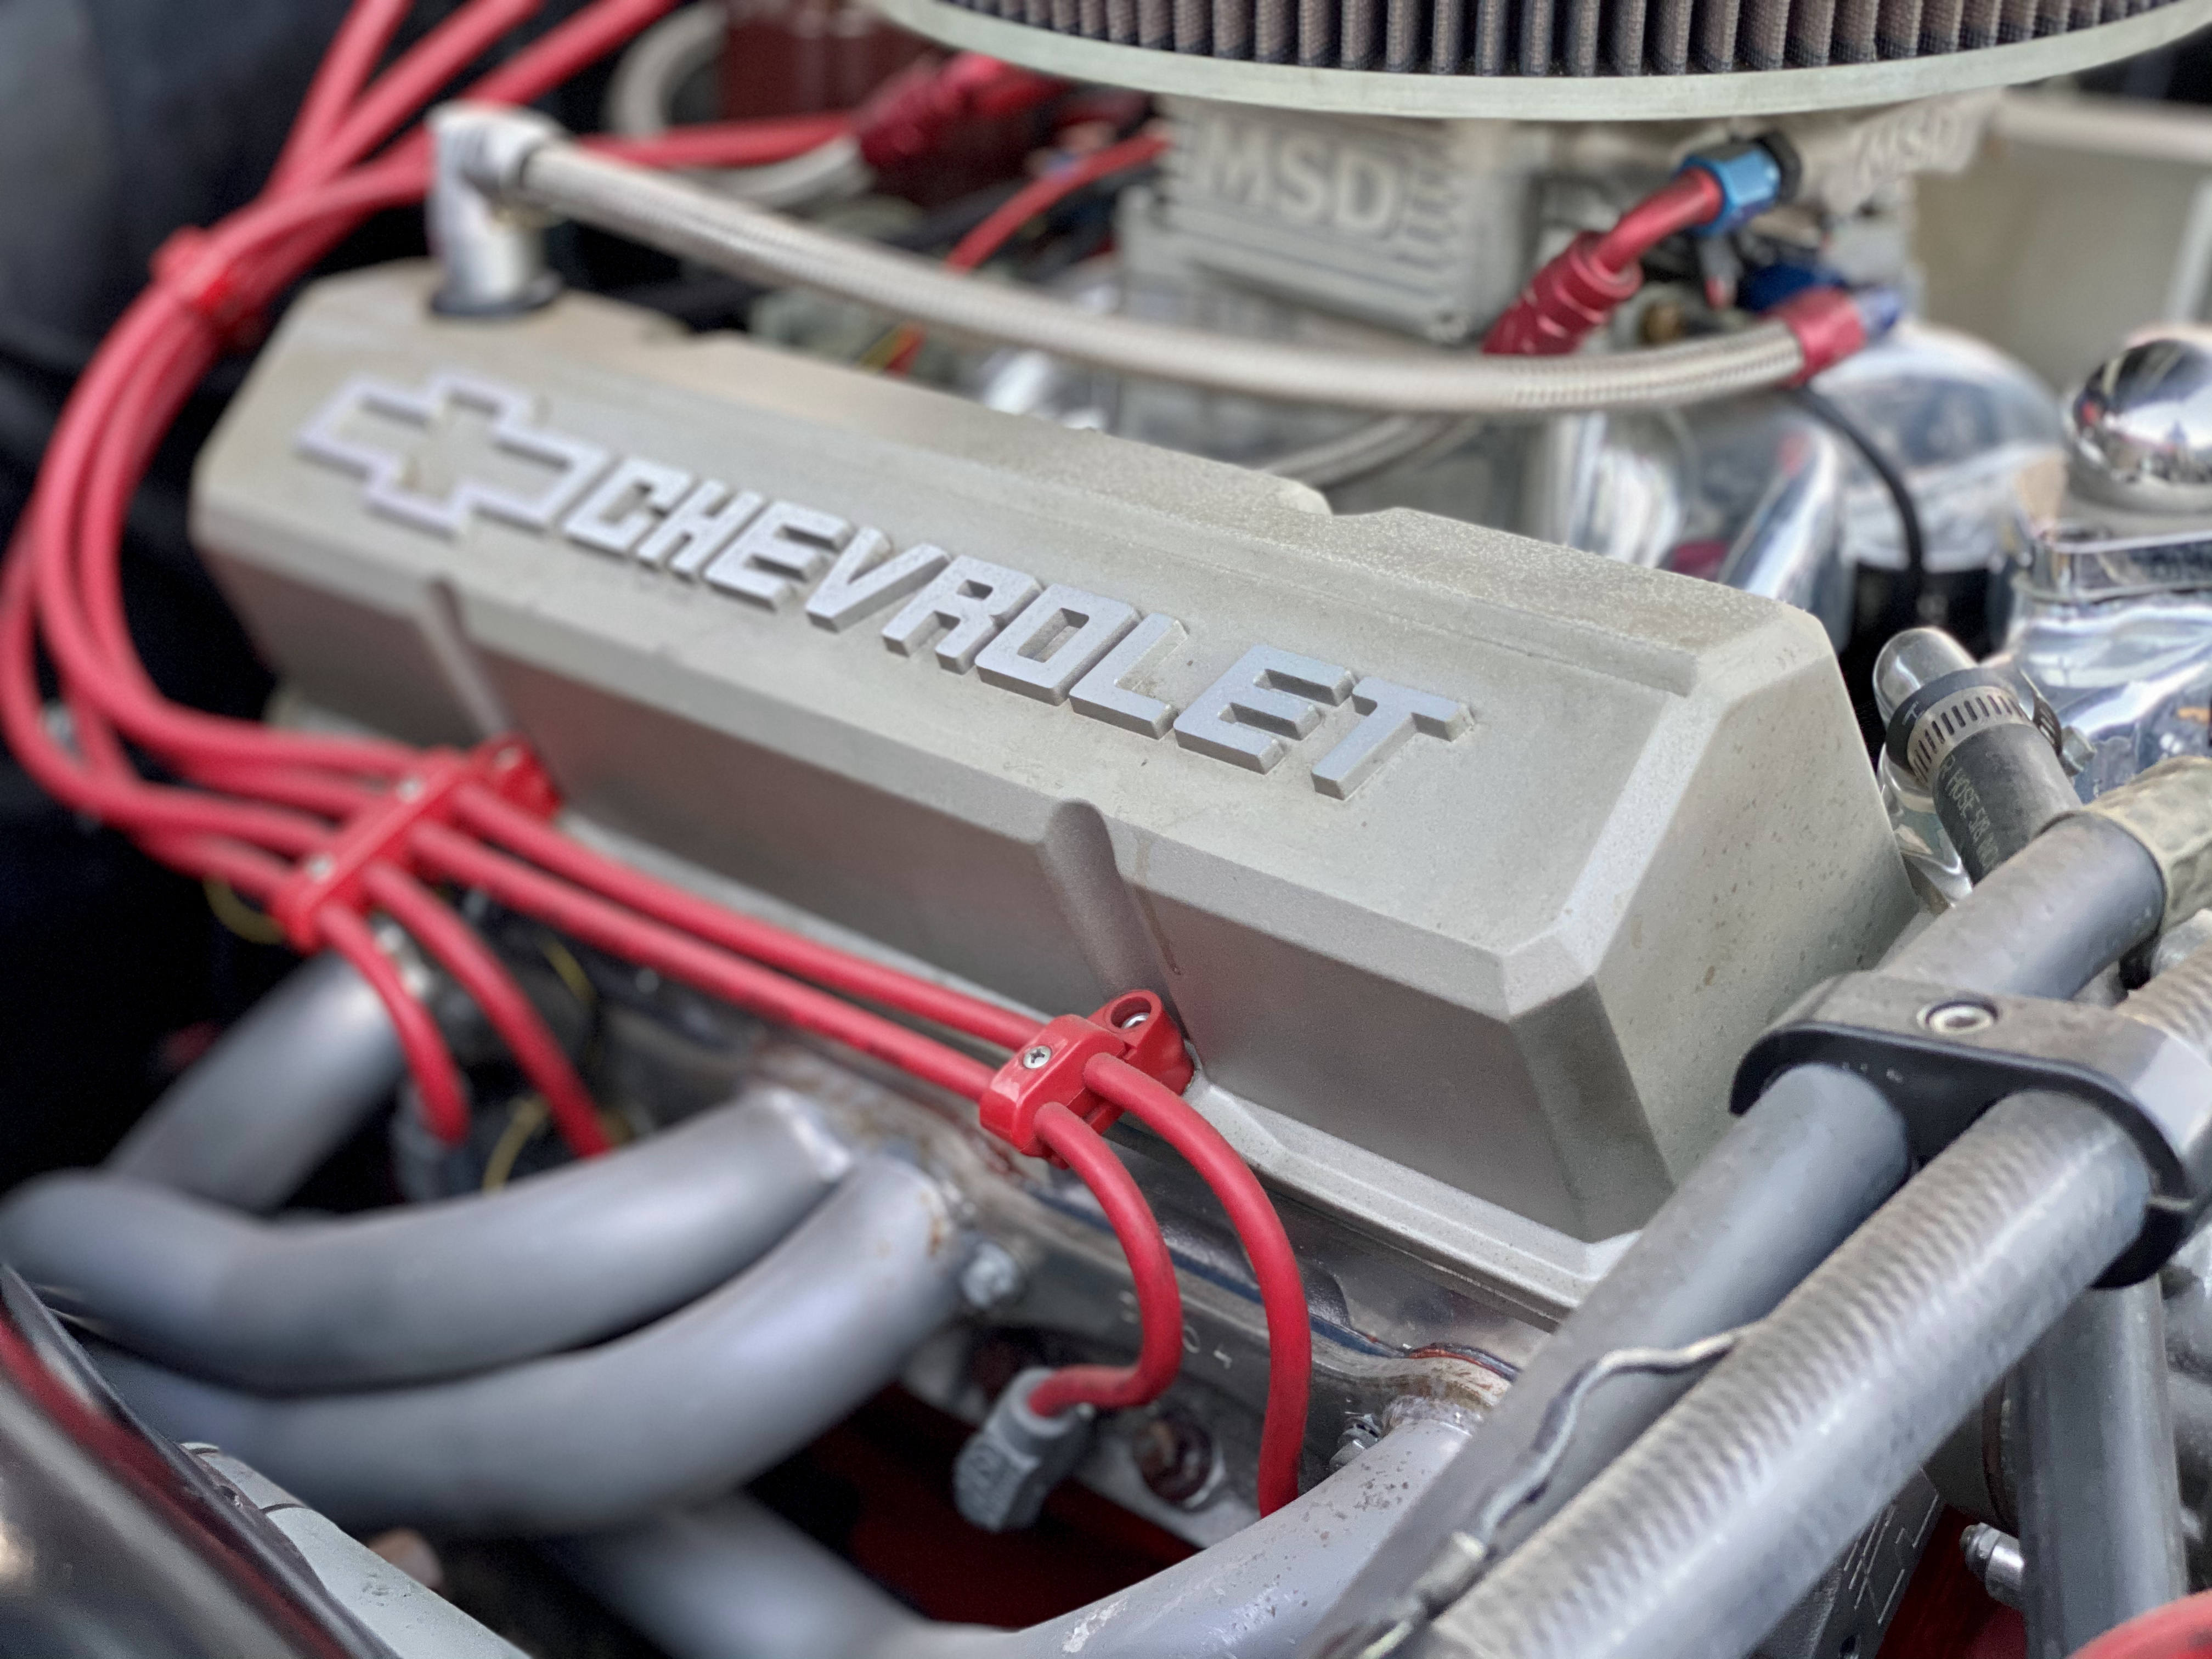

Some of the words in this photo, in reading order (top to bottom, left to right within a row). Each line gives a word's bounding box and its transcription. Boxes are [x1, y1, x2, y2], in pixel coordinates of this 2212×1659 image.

[1205, 114, 1398, 230] MSD
[562, 458, 1471, 800] CHEVROLET
[1945, 768, 1980, 819] HOSE
